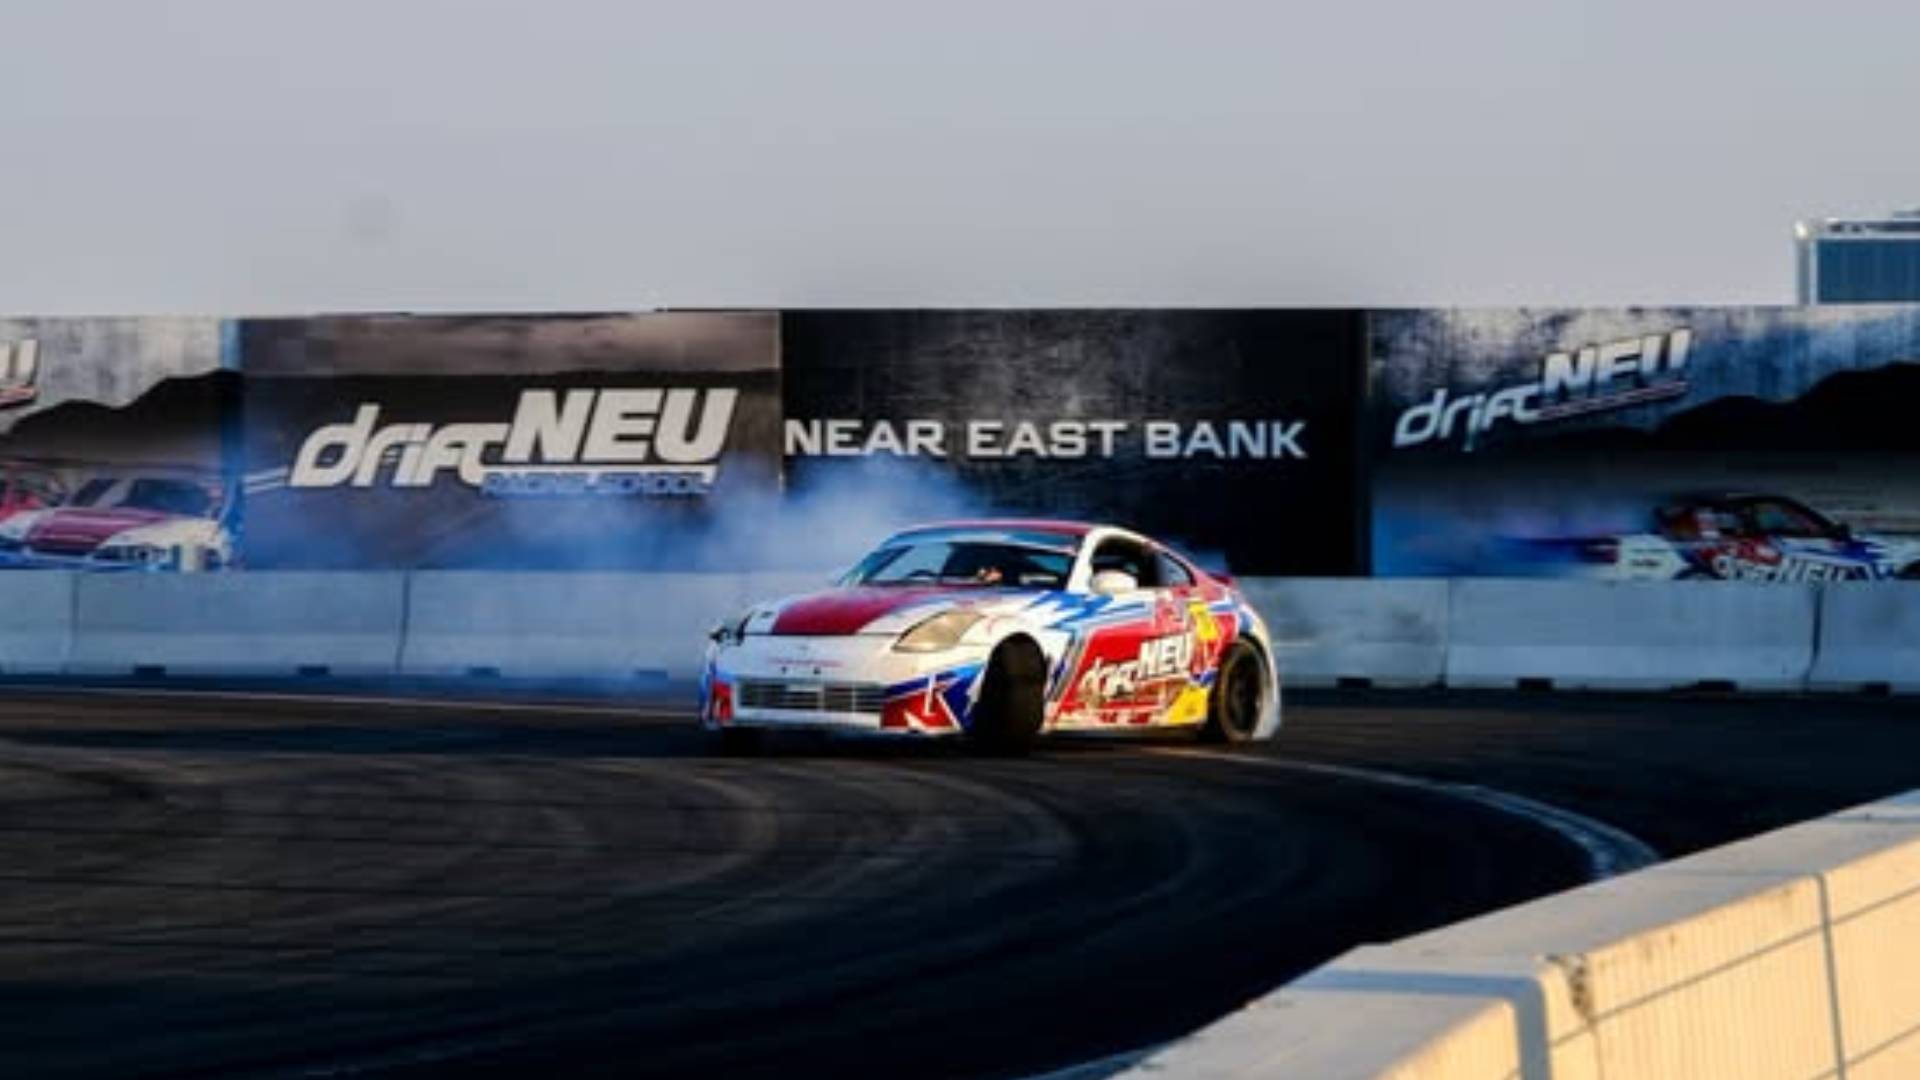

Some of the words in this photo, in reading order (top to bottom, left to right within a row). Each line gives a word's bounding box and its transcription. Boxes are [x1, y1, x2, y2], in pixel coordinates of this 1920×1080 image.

[784, 418, 947, 458] NEAR
[966, 419, 1127, 459] EAST
[1144, 420, 1307, 460] BANK
